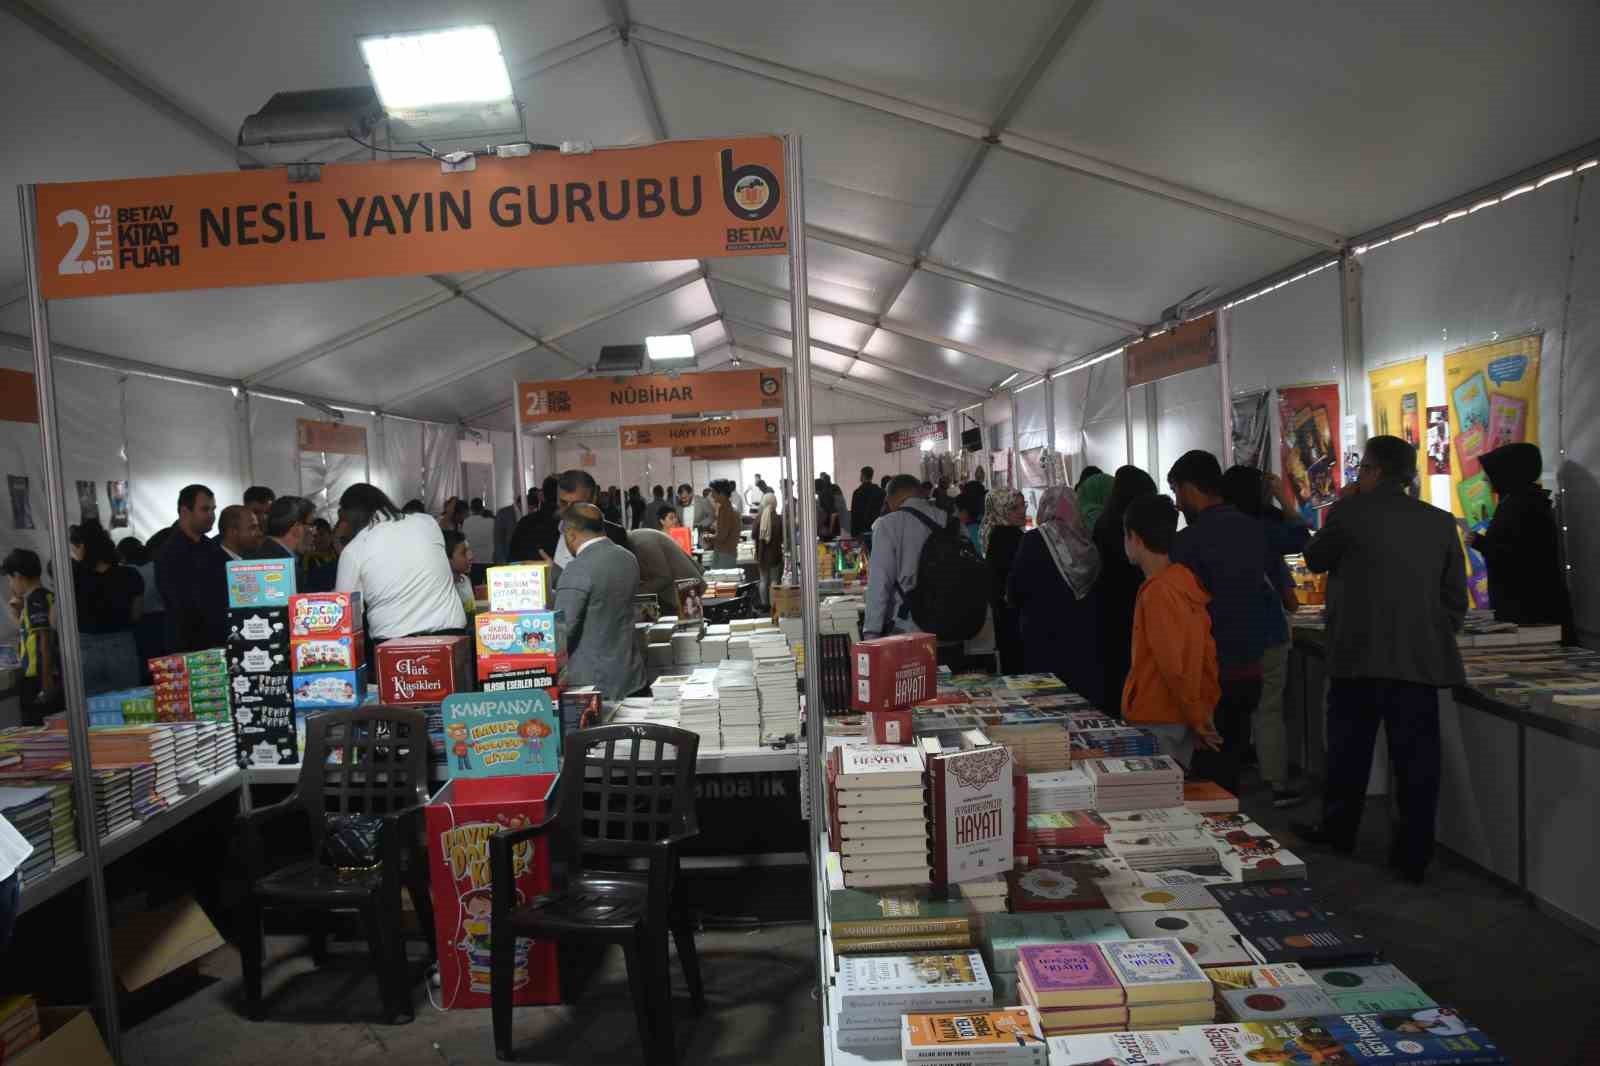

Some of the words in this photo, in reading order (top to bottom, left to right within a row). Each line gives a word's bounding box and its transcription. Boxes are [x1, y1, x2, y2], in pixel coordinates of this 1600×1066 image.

[117, 205, 174, 223] BETAV
[200, 191, 325, 248] NESİL
[337, 189, 472, 238] YAYIN
[488, 174, 701, 228] GURUBU
[56, 208, 97, 275] 2.
[92, 204, 114, 271] BİTLİS
[117, 223, 179, 248] KİTAP
[726, 227, 784, 243] BETAV
[118, 246, 181, 270] FUARI
[396, 657, 429, 677] Türk
[391, 675, 442, 699] Klasikleri
[895, 674, 926, 705] HAYATI
[450, 699, 545, 720] KAMPANYA
[954, 808, 1003, 844] HAYATI
